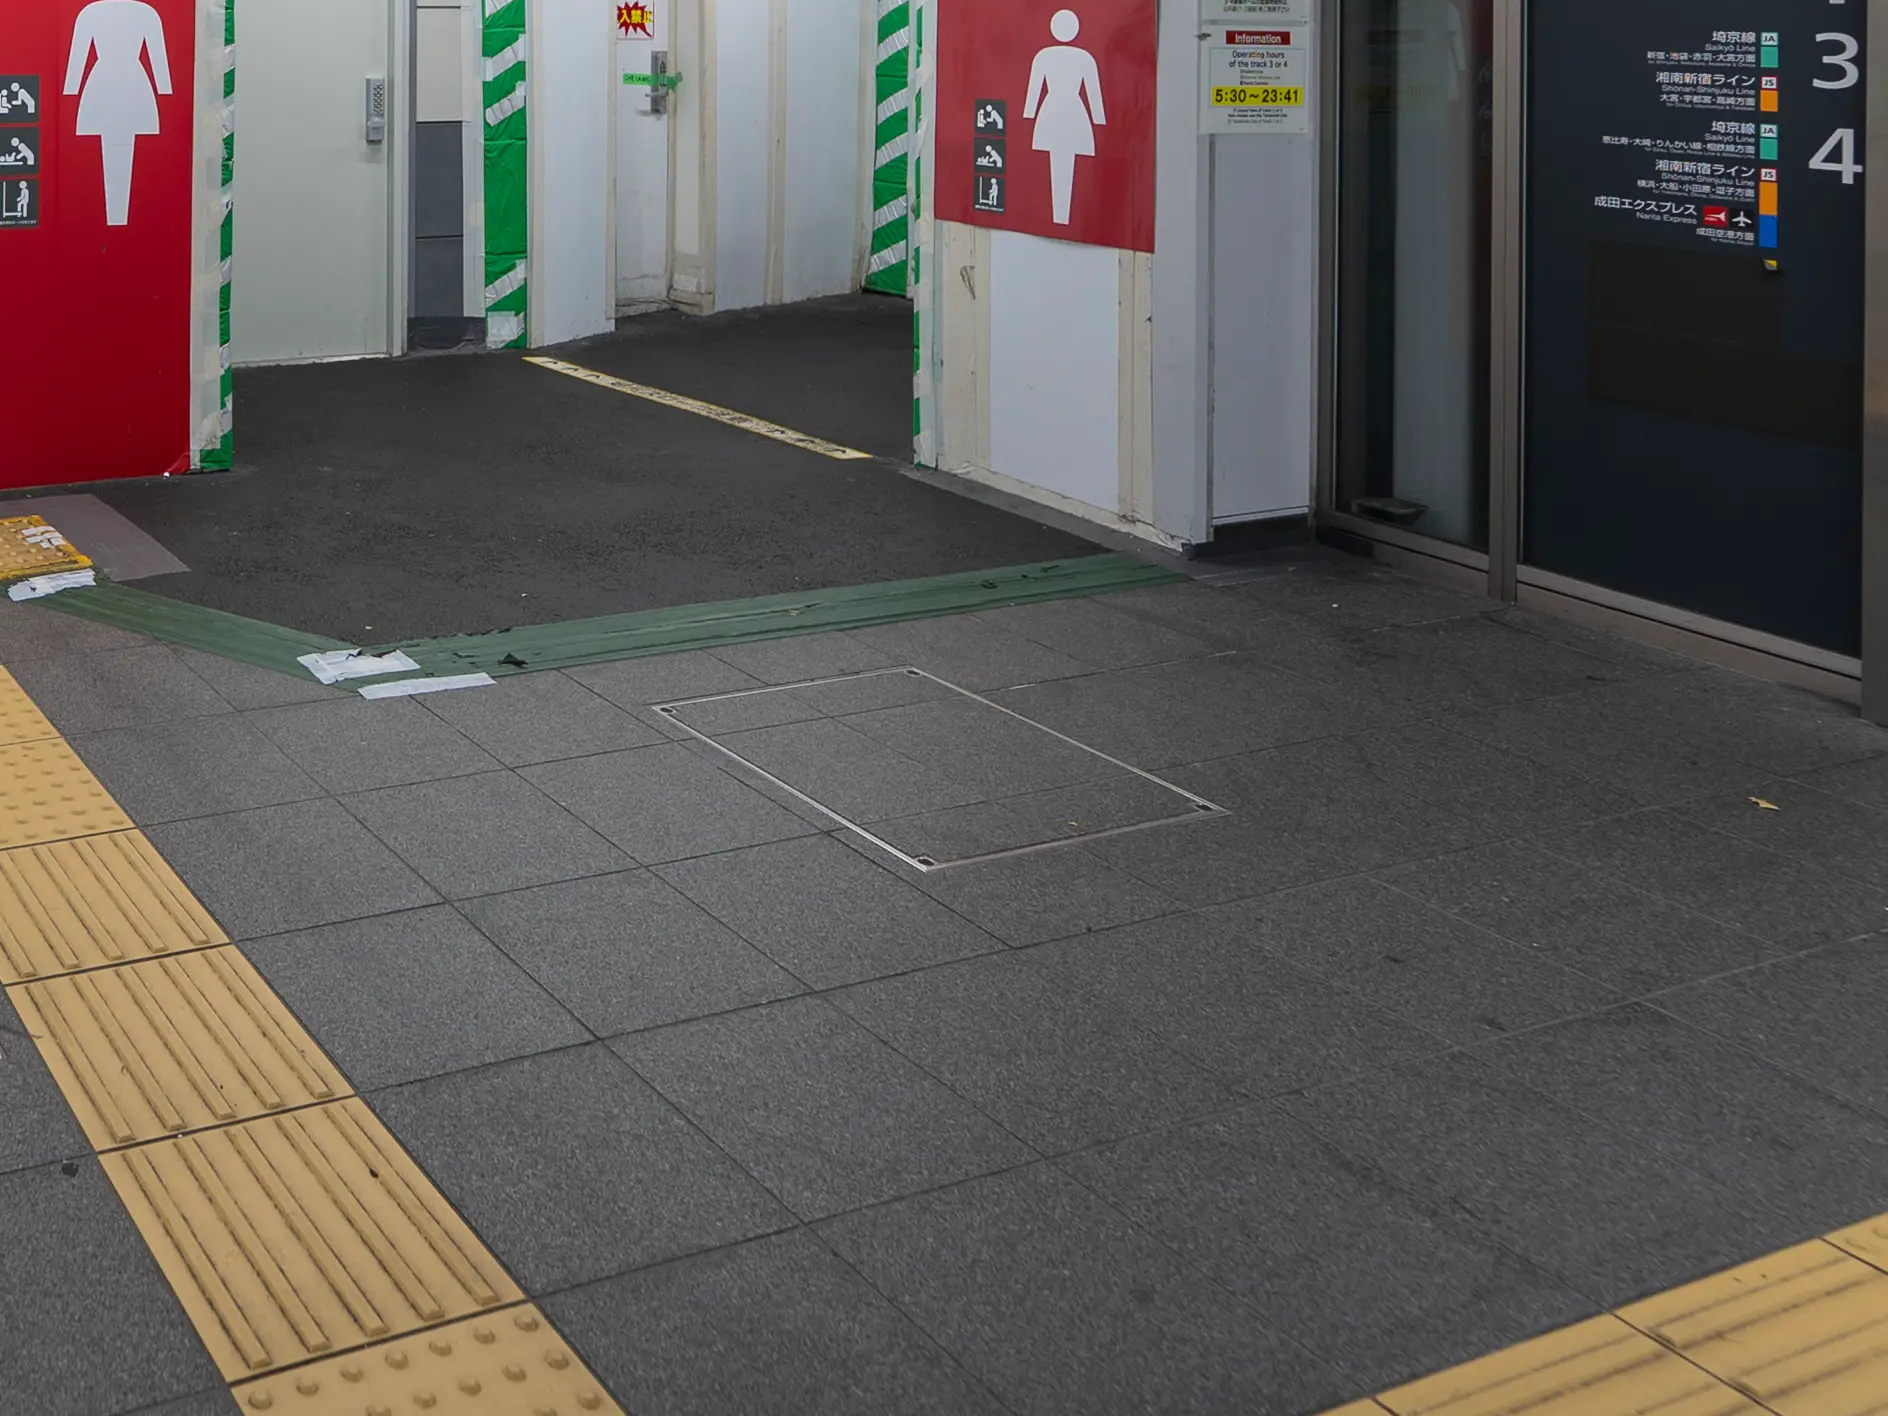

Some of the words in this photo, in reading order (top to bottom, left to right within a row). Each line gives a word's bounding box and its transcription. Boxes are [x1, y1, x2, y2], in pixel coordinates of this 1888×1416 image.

[617, 9, 653, 24] 入禁止
[1235, 34, 1281, 43] Information
[1712, 31, 1756, 43] 埼京線
[1763, 35, 1775, 43] JA
[1737, 44, 1756, 52] Line
[1232, 50, 1265, 59] Operating
[1266, 51, 1285, 59] hours
[1229, 60, 1236, 68] of
[1238, 60, 1249, 68] the
[1250, 60, 1268, 68] track
[1269, 60, 1274, 68] 3
[1283, 60, 1288, 68] 4
[1812, 32, 1860, 89] 3
[1656, 72, 1755, 86] 湘南新宿ライン
[1764, 79, 1774, 87] JS
[1736, 87, 1755, 95] Line
[1711, 121, 1755, 134] 埼京線
[1763, 127, 1775, 135] JA
[1736, 135, 1755, 143] Line
[1808, 128, 1863, 184] 4
[1655, 159, 1755, 177] 湘南新宿ライン
[1763, 171, 1774, 179] JS
[1735, 178, 1755, 186] Line
[1594, 196, 1697, 216] 成田エクスプレス
[1636, 211, 1661, 221] Narita
[1663, 214, 1697, 225] Express
